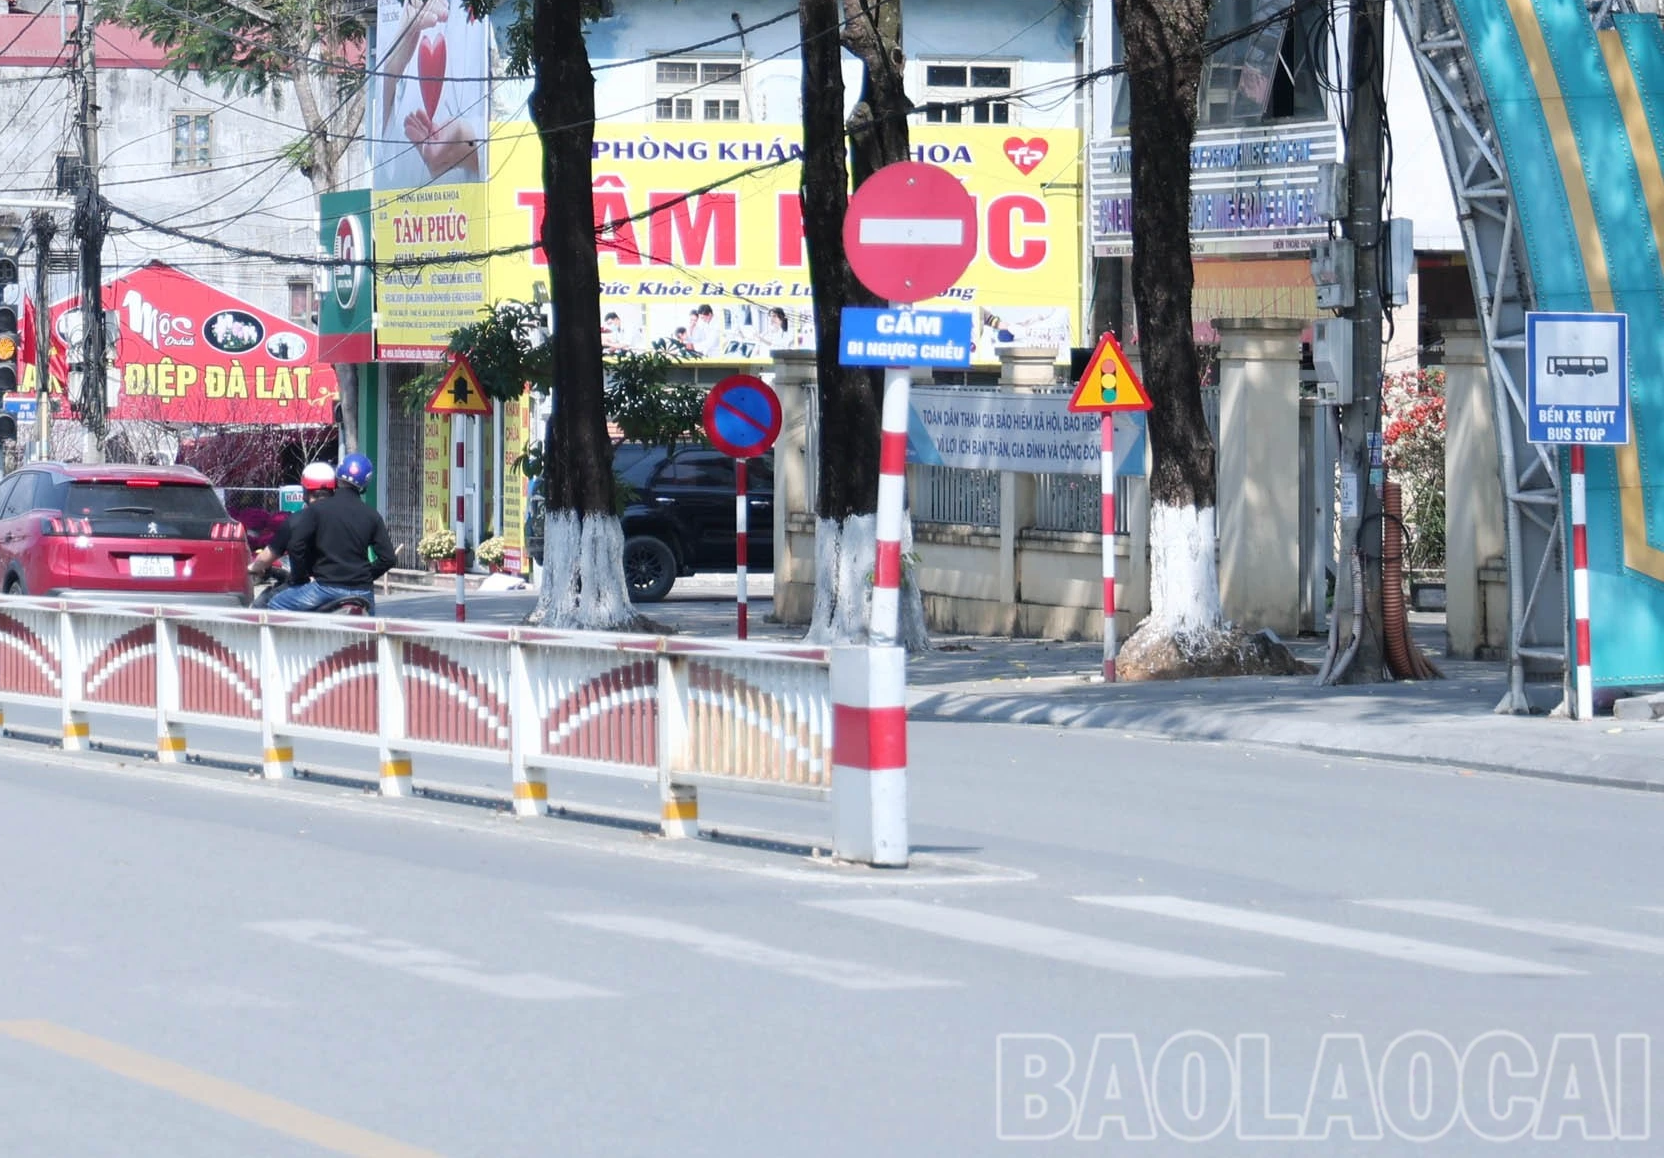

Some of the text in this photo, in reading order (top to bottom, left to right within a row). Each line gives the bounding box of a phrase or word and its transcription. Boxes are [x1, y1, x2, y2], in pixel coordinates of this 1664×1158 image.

[592, 136, 708, 161] PHÒNG
[909, 144, 972, 164] HOA
[393, 209, 424, 243] TÂM
[427, 207, 467, 242] PHÚC
[638, 282, 692, 297] Khỏe
[702, 282, 724, 297] Là
[734, 281, 783, 297] Chất
[876, 305, 941, 336] CẤM
[847, 341, 864, 356] ĐI
[866, 341, 919, 360] NGƯỢC
[124, 357, 198, 403] ĐIỆP
[204, 360, 248, 399] ĐÀ
[255, 366, 312, 406] LẠT
[960, 410, 981, 427] THAM
[982, 413, 995, 428] GIA
[1539, 405, 1563, 423] BẾN
[1567, 409, 1582, 423] XE
[1547, 427, 1606, 441] BUS STOP
[1012, 442, 1025, 458] GIA
[1027, 438, 1045, 458] ĐÌNH
[1047, 440, 1057, 459] VÀ
